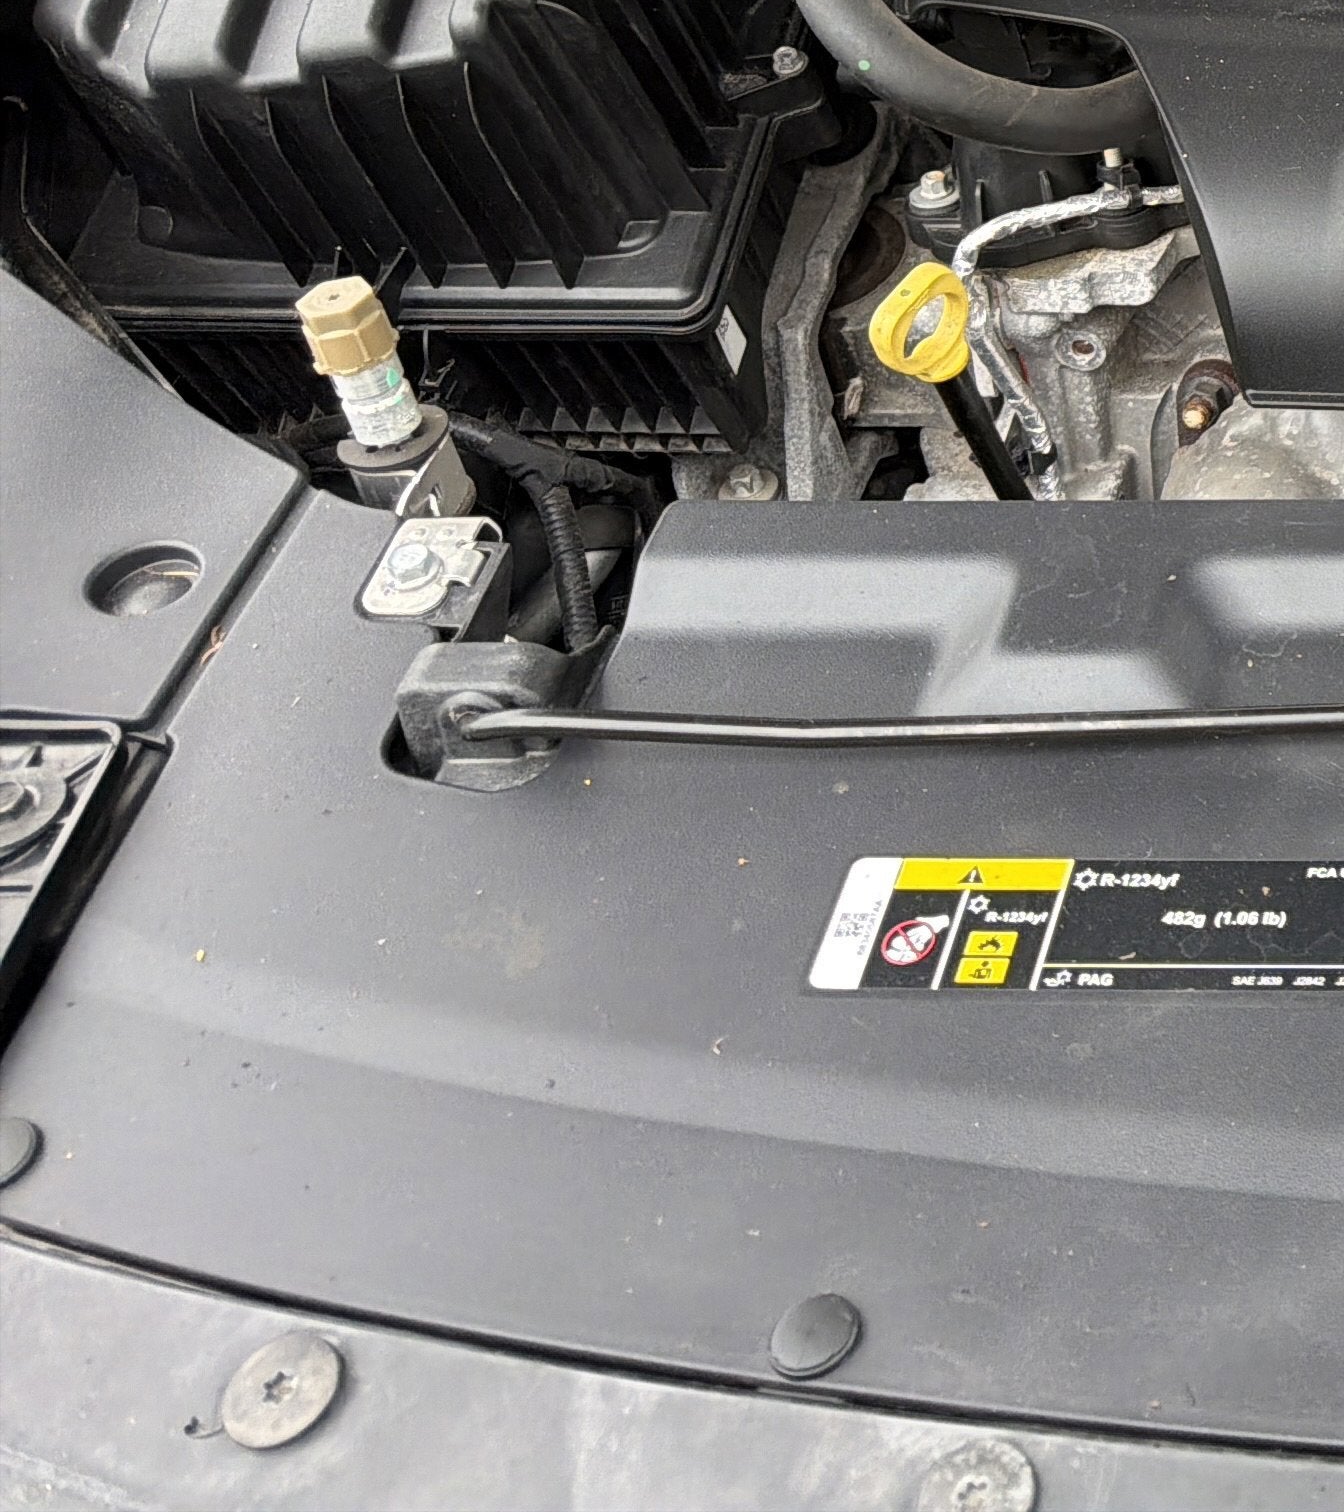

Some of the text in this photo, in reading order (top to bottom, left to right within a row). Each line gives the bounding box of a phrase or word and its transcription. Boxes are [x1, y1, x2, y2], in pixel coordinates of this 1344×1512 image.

[1100, 872, 1180, 890] R-1234yf
[1306, 867, 1338, 879] FCA
[984, 911, 1049, 925] R-1234yf
[1161, 911, 1288, 928] 482g (1.06 lb)
[1077, 973, 1114, 986] PAG
[1231, 976, 1255, 986] SAE
